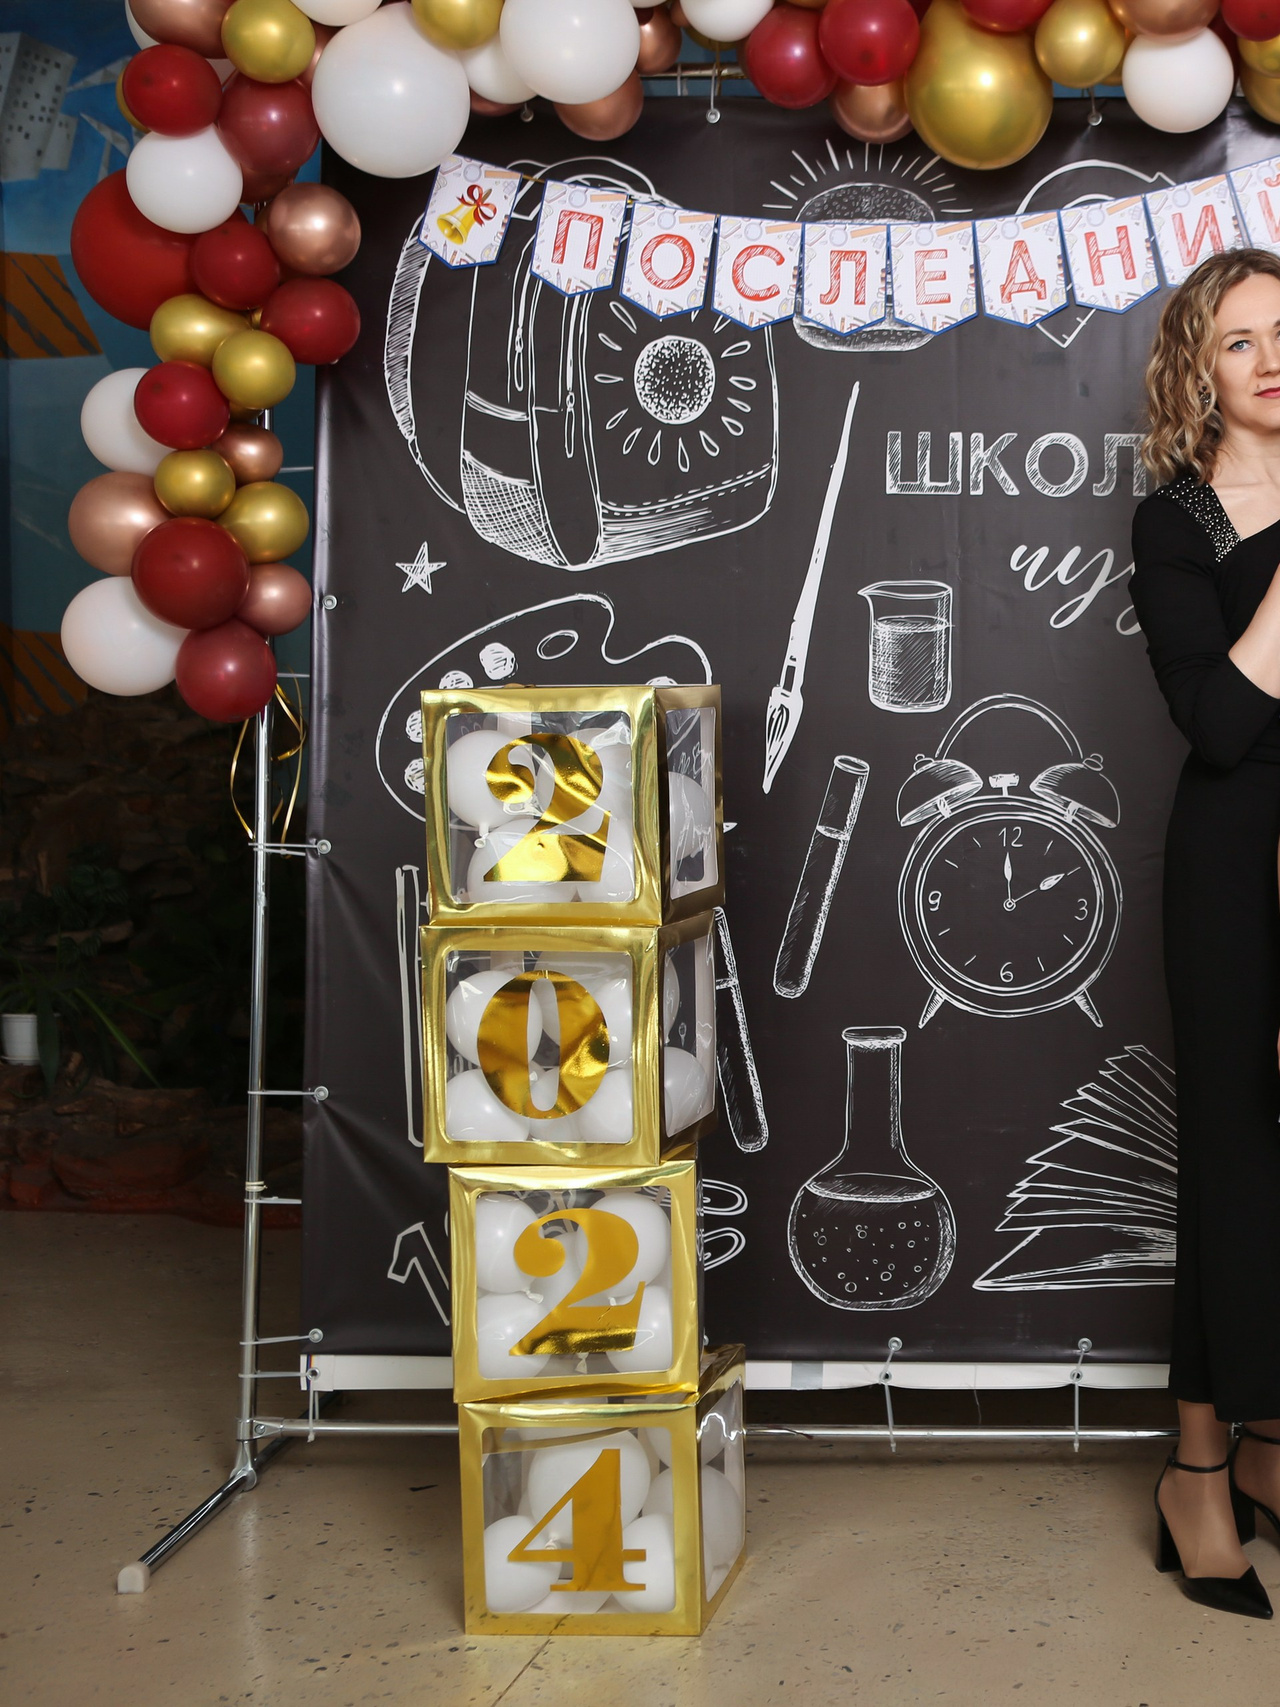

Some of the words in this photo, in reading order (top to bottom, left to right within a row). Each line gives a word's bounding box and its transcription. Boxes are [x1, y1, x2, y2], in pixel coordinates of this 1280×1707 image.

[998, 826, 1023, 848] 12
[928, 890, 942, 911] 9
[1074, 898, 1088, 920] 3
[1000, 962, 1014, 982] 6
